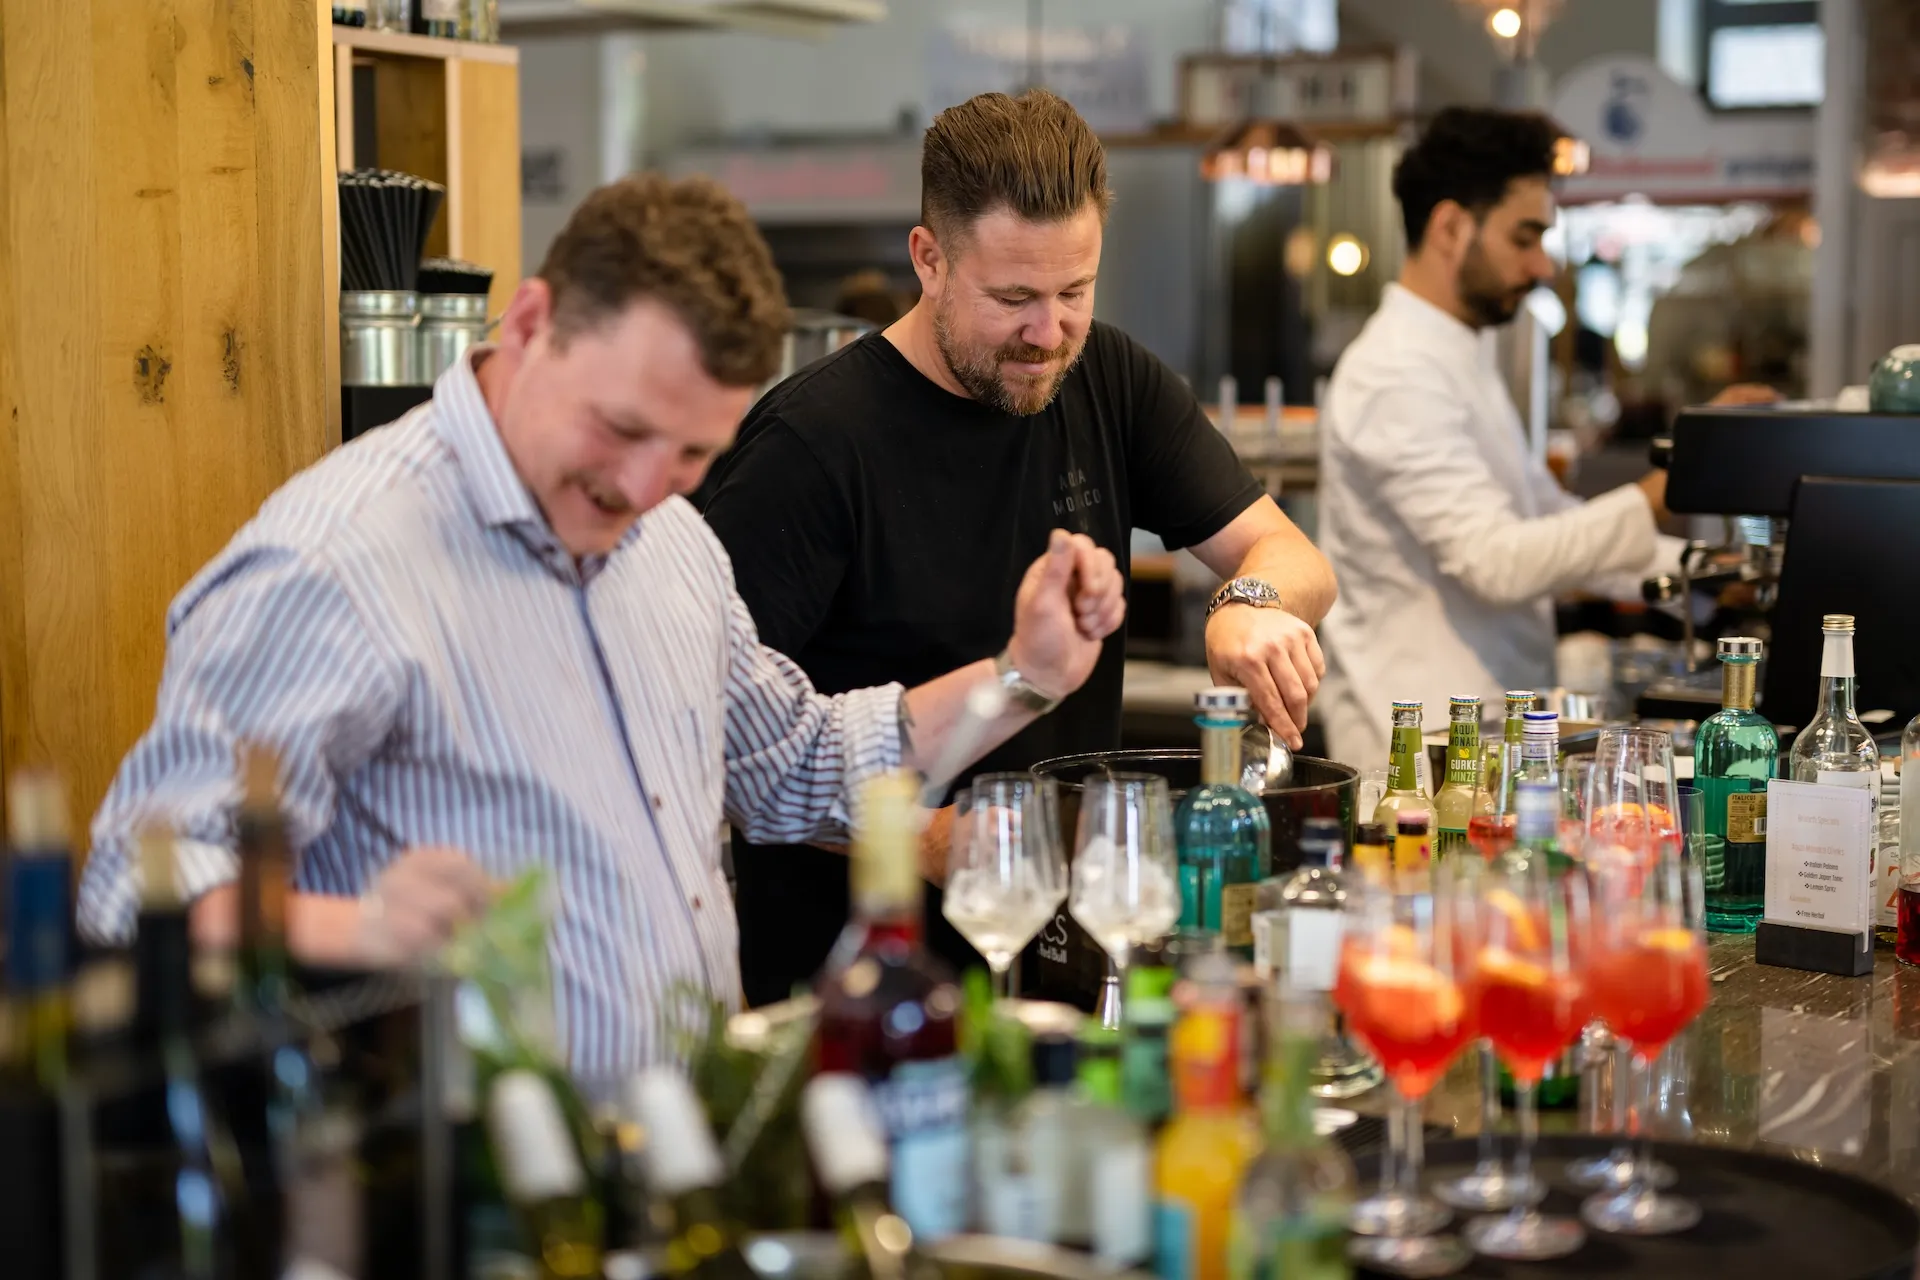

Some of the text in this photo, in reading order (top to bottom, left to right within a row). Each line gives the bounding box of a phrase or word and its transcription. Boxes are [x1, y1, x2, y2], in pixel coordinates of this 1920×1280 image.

[1052, 488, 1101, 516] MOCO
[1454, 724, 1475, 735] AQUA
[1450, 759, 1477, 770] GURKE
[1450, 771, 1477, 783] MINZE
